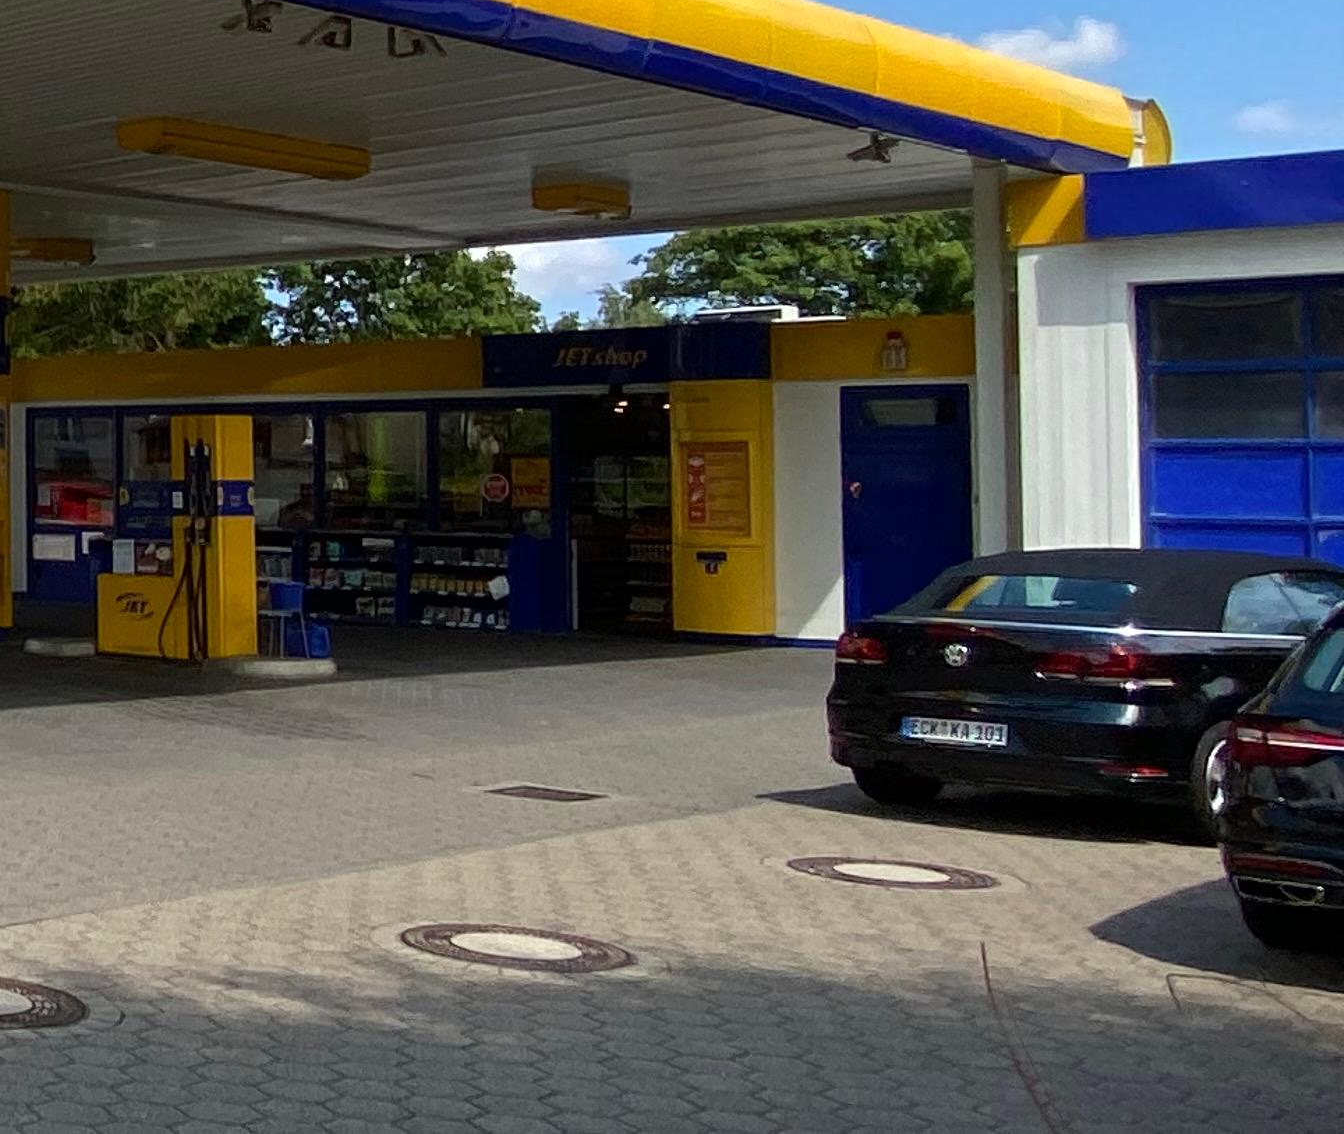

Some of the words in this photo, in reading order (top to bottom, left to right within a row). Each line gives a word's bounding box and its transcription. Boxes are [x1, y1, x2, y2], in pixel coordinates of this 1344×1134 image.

[552, 347, 593, 368] JET
[594, 345, 648, 369] shop
[120, 601, 149, 614] JET
